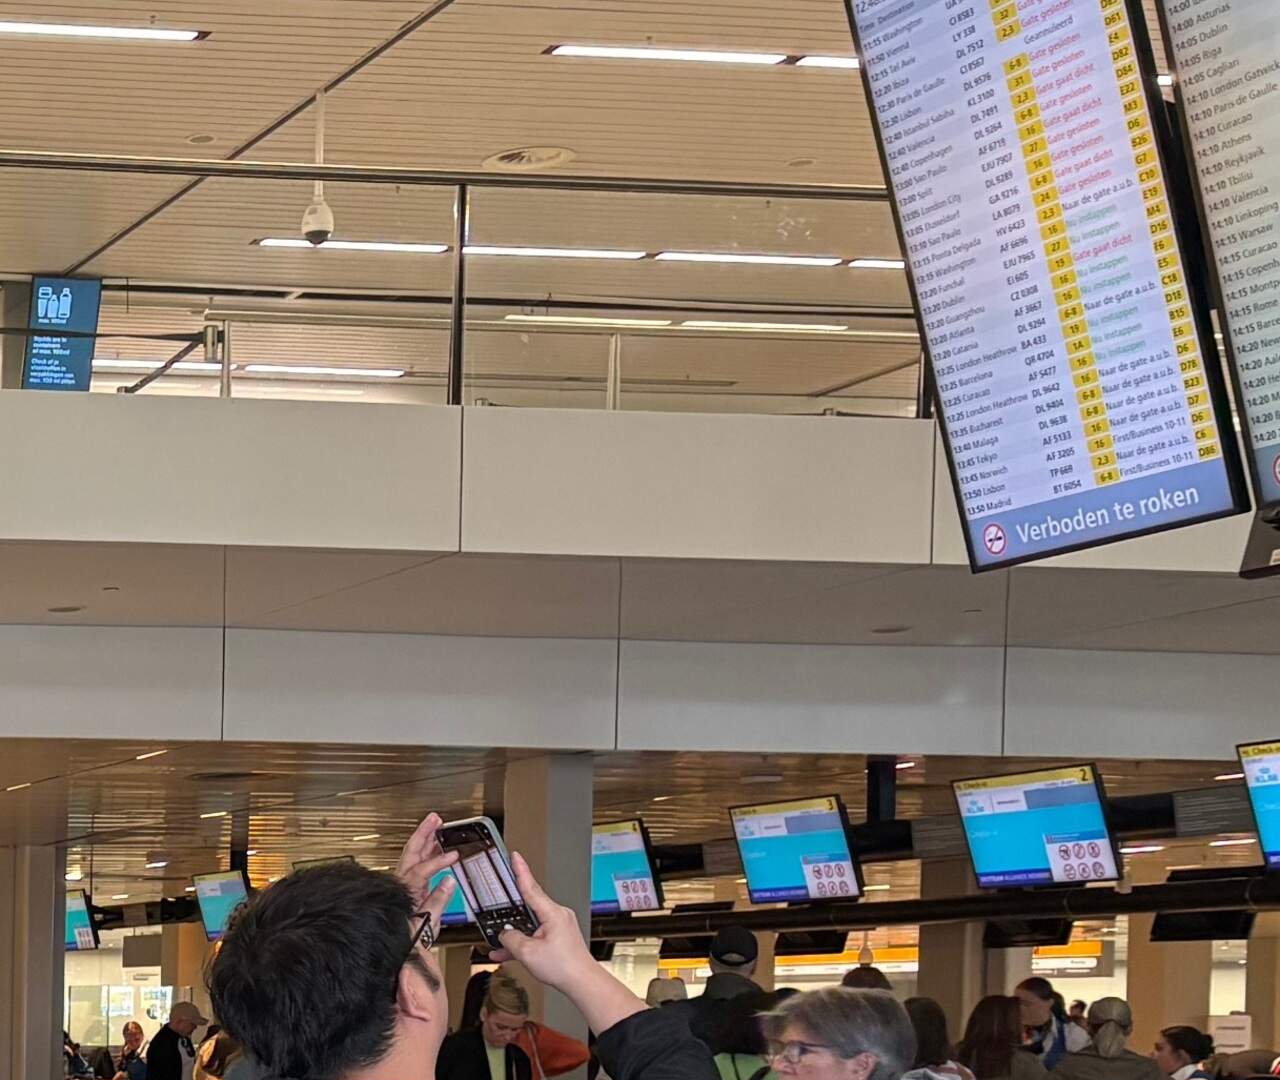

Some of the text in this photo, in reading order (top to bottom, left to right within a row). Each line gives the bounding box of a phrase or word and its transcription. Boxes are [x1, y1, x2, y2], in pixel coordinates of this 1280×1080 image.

[1199, 24, 1228, 41] Dublin
[1202, 46, 1222, 59] Riga
[1209, 76, 1243, 95] London
[1235, 94, 1246, 104] de
[1248, 82, 1277, 98] Gaulle
[1220, 131, 1252, 148] Athens
[1093, 187, 1111, 204] gate
[1231, 183, 1268, 202] Valencia
[1237, 221, 1273, 238] Warsaw
[1241, 239, 1277, 256] Curacao
[1115, 289, 1133, 304] gate
[1129, 356, 1148, 371] gate
[1133, 373, 1151, 388] gate
[1136, 390, 1155, 404] gate
[1140, 406, 1158, 421] gate
[1164, 415, 1186, 429] 10-11
[1147, 439, 1166, 454] gate
[1171, 449, 1193, 463] 10-11
[1016, 487, 1200, 544] Verboden te roken
[1079, 768, 1089, 782] 2
[826, 798, 834, 811] 3
